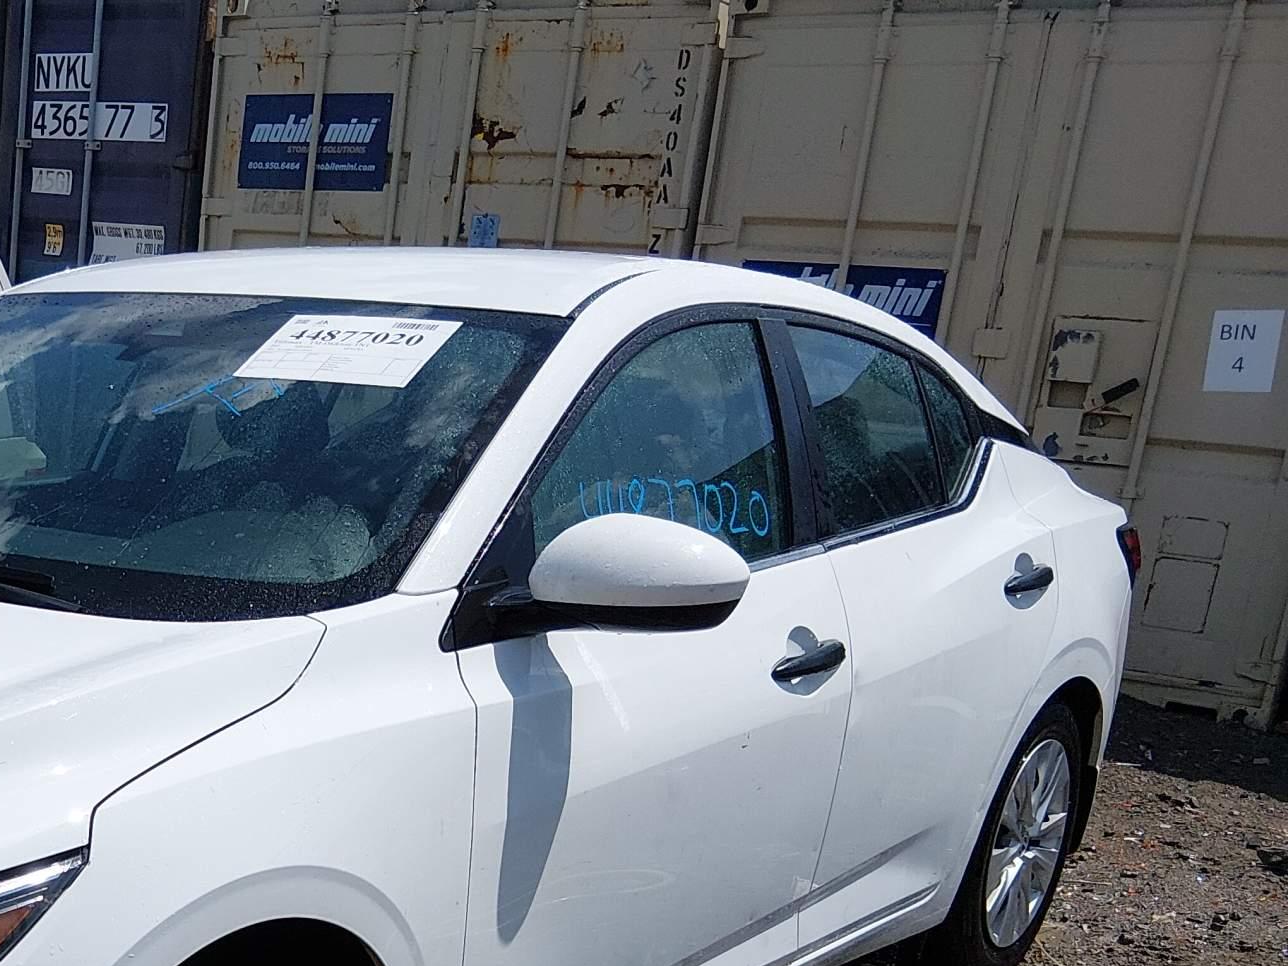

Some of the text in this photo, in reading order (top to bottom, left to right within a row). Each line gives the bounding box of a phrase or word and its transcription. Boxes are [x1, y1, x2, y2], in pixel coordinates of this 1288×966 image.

[36, 55, 92, 89] NYKU
[324, 118, 379, 144] mini
[289, 328, 425, 347] 44877020
[1219, 324, 1257, 341] BIN
[1231, 356, 1245, 373] 4
